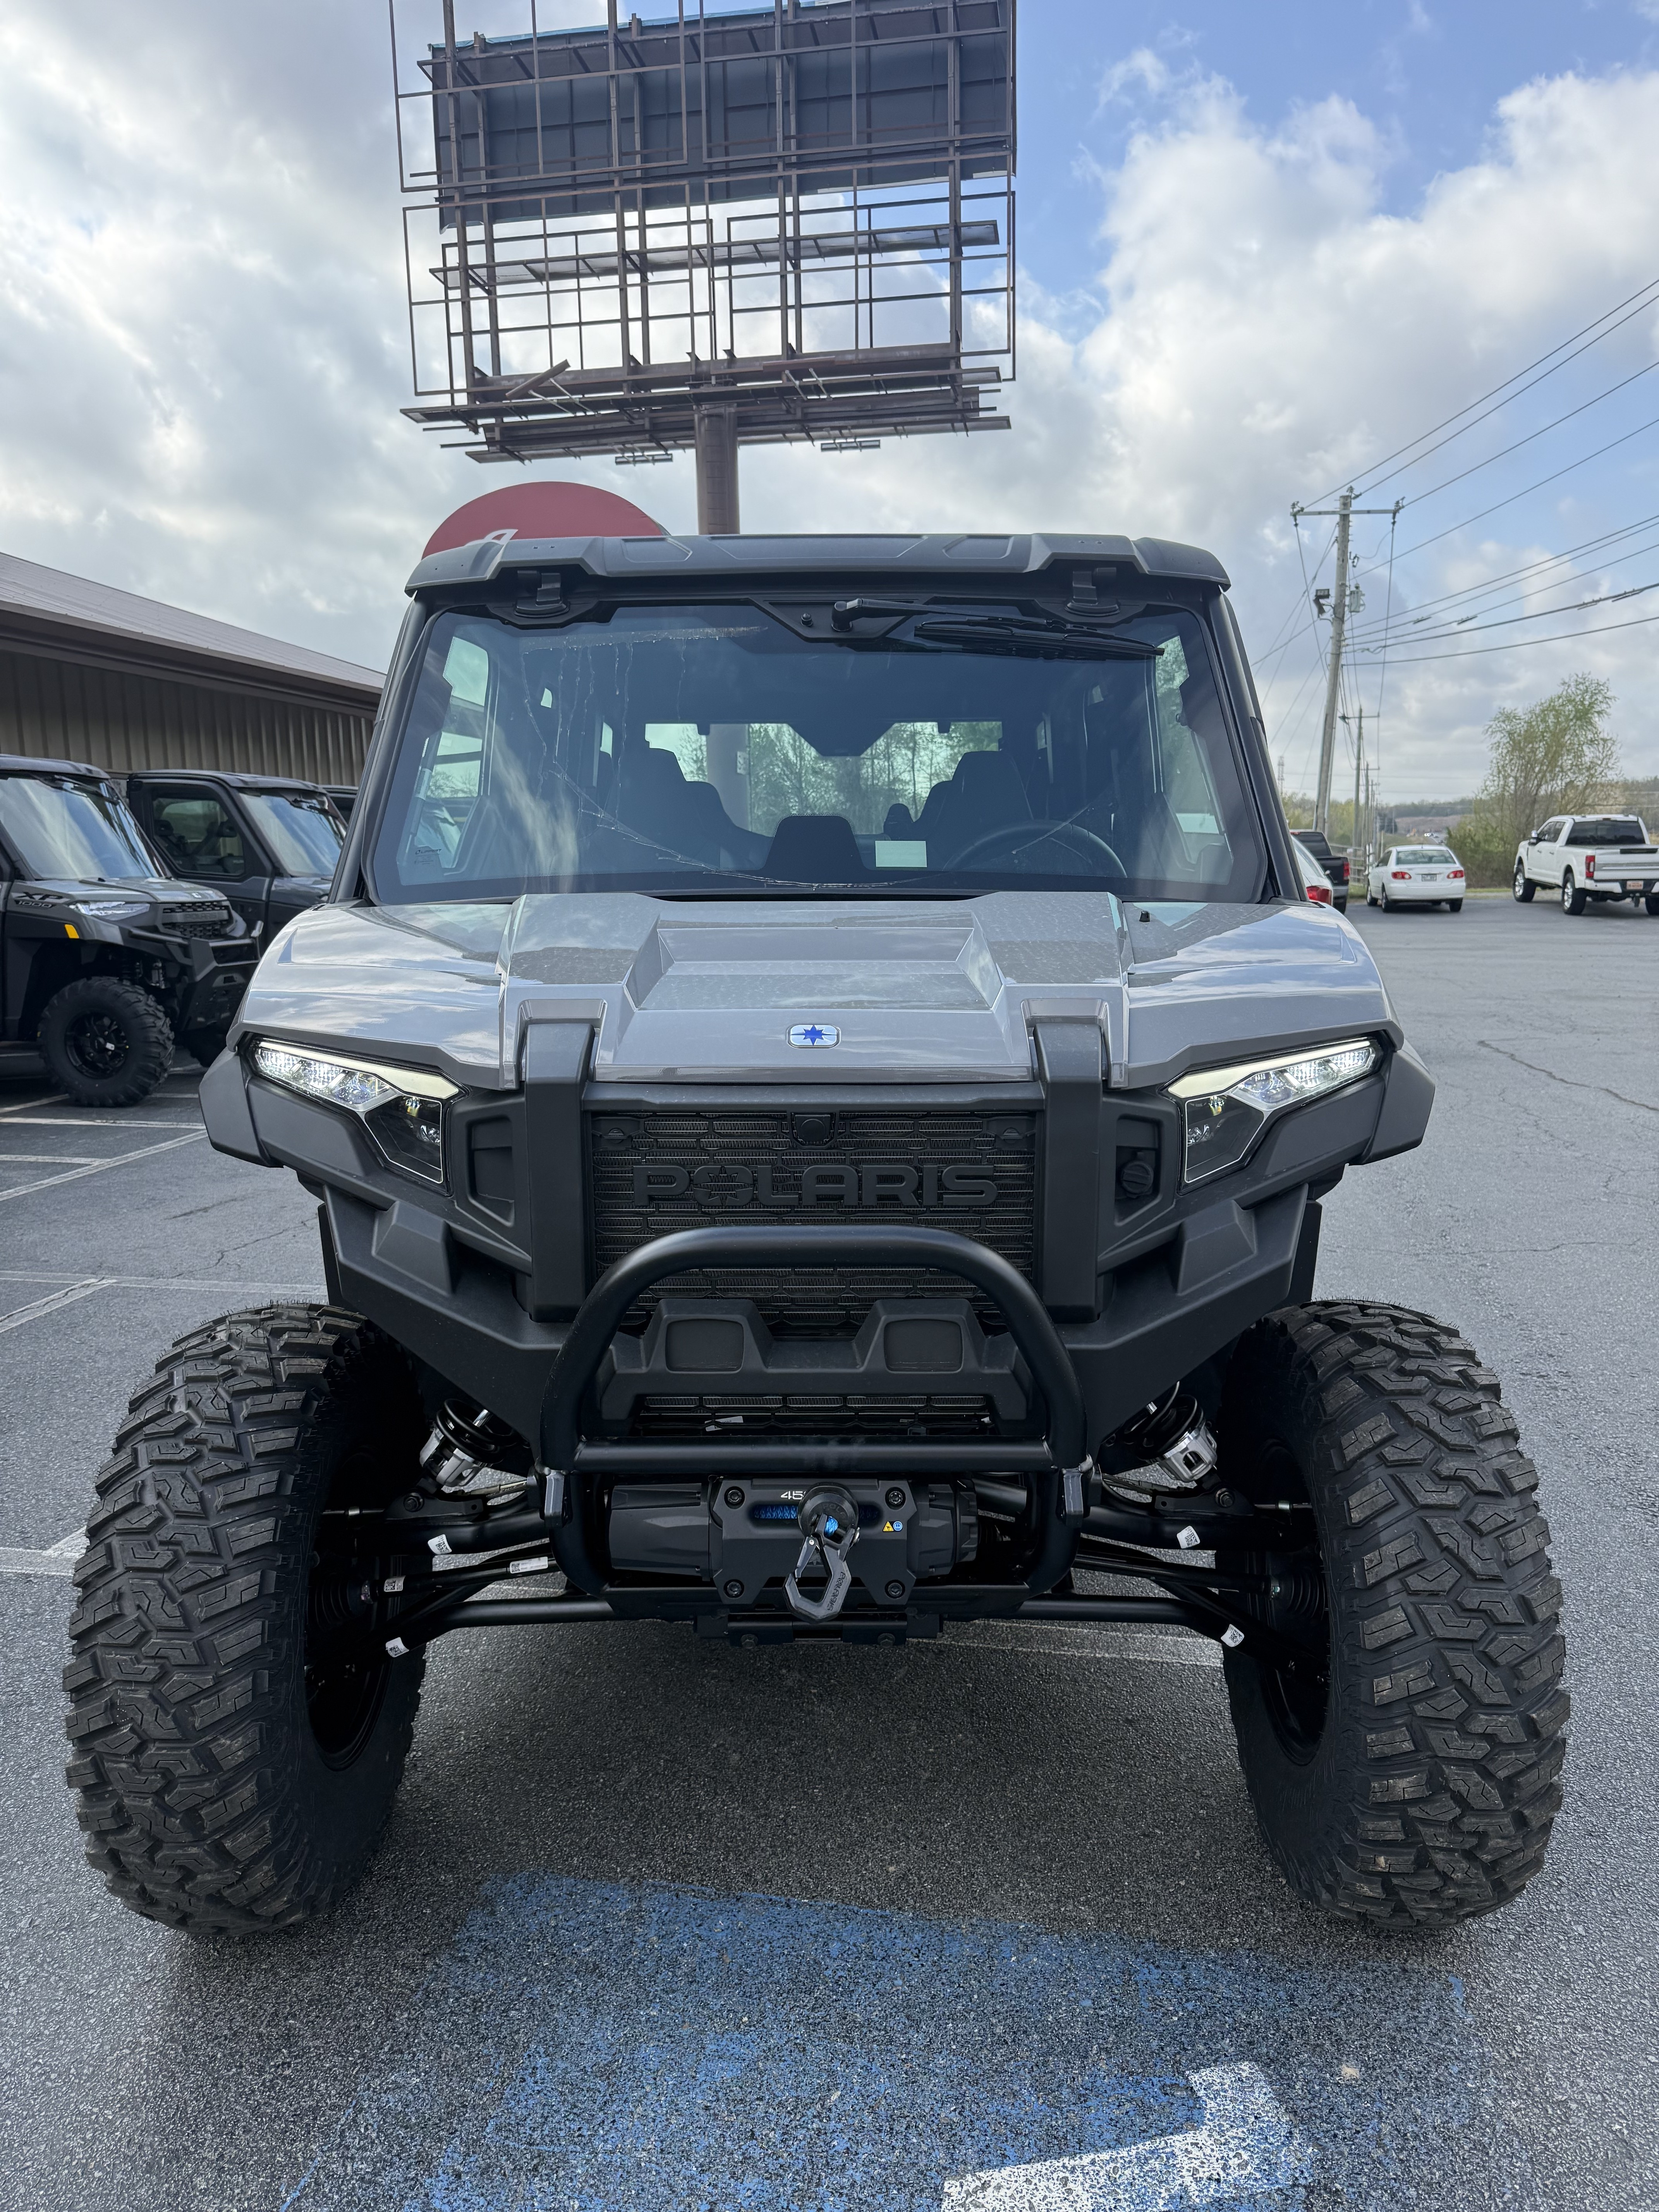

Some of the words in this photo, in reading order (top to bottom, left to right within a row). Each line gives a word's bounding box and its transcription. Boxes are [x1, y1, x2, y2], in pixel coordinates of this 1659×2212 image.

[15, 891, 64, 900] XP
[633, 1164, 998, 1206] POLARIS
[780, 1491, 806, 1500] 45
[827, 1571, 846, 1611] POLARIS
